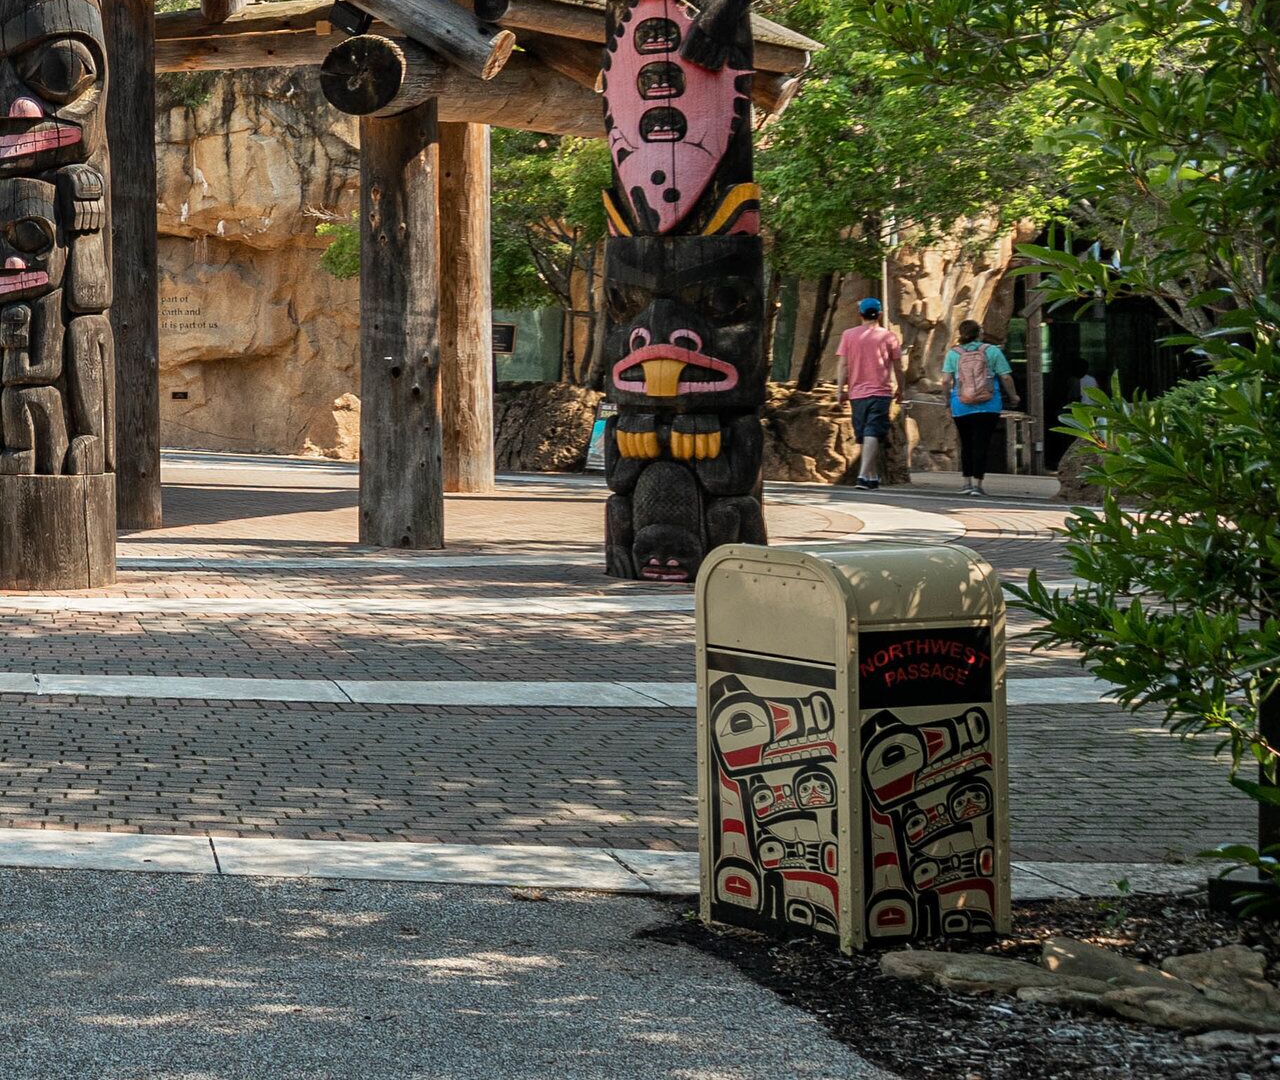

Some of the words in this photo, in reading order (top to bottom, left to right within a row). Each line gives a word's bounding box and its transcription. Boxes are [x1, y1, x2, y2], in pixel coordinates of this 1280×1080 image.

[161, 296, 177, 305] part
[184, 307, 201, 316] and
[179, 321, 196, 331] part
[197, 320, 207, 329] of
[860, 639, 990, 678] NORTHWEST
[884, 662, 967, 687] PASSAGE
